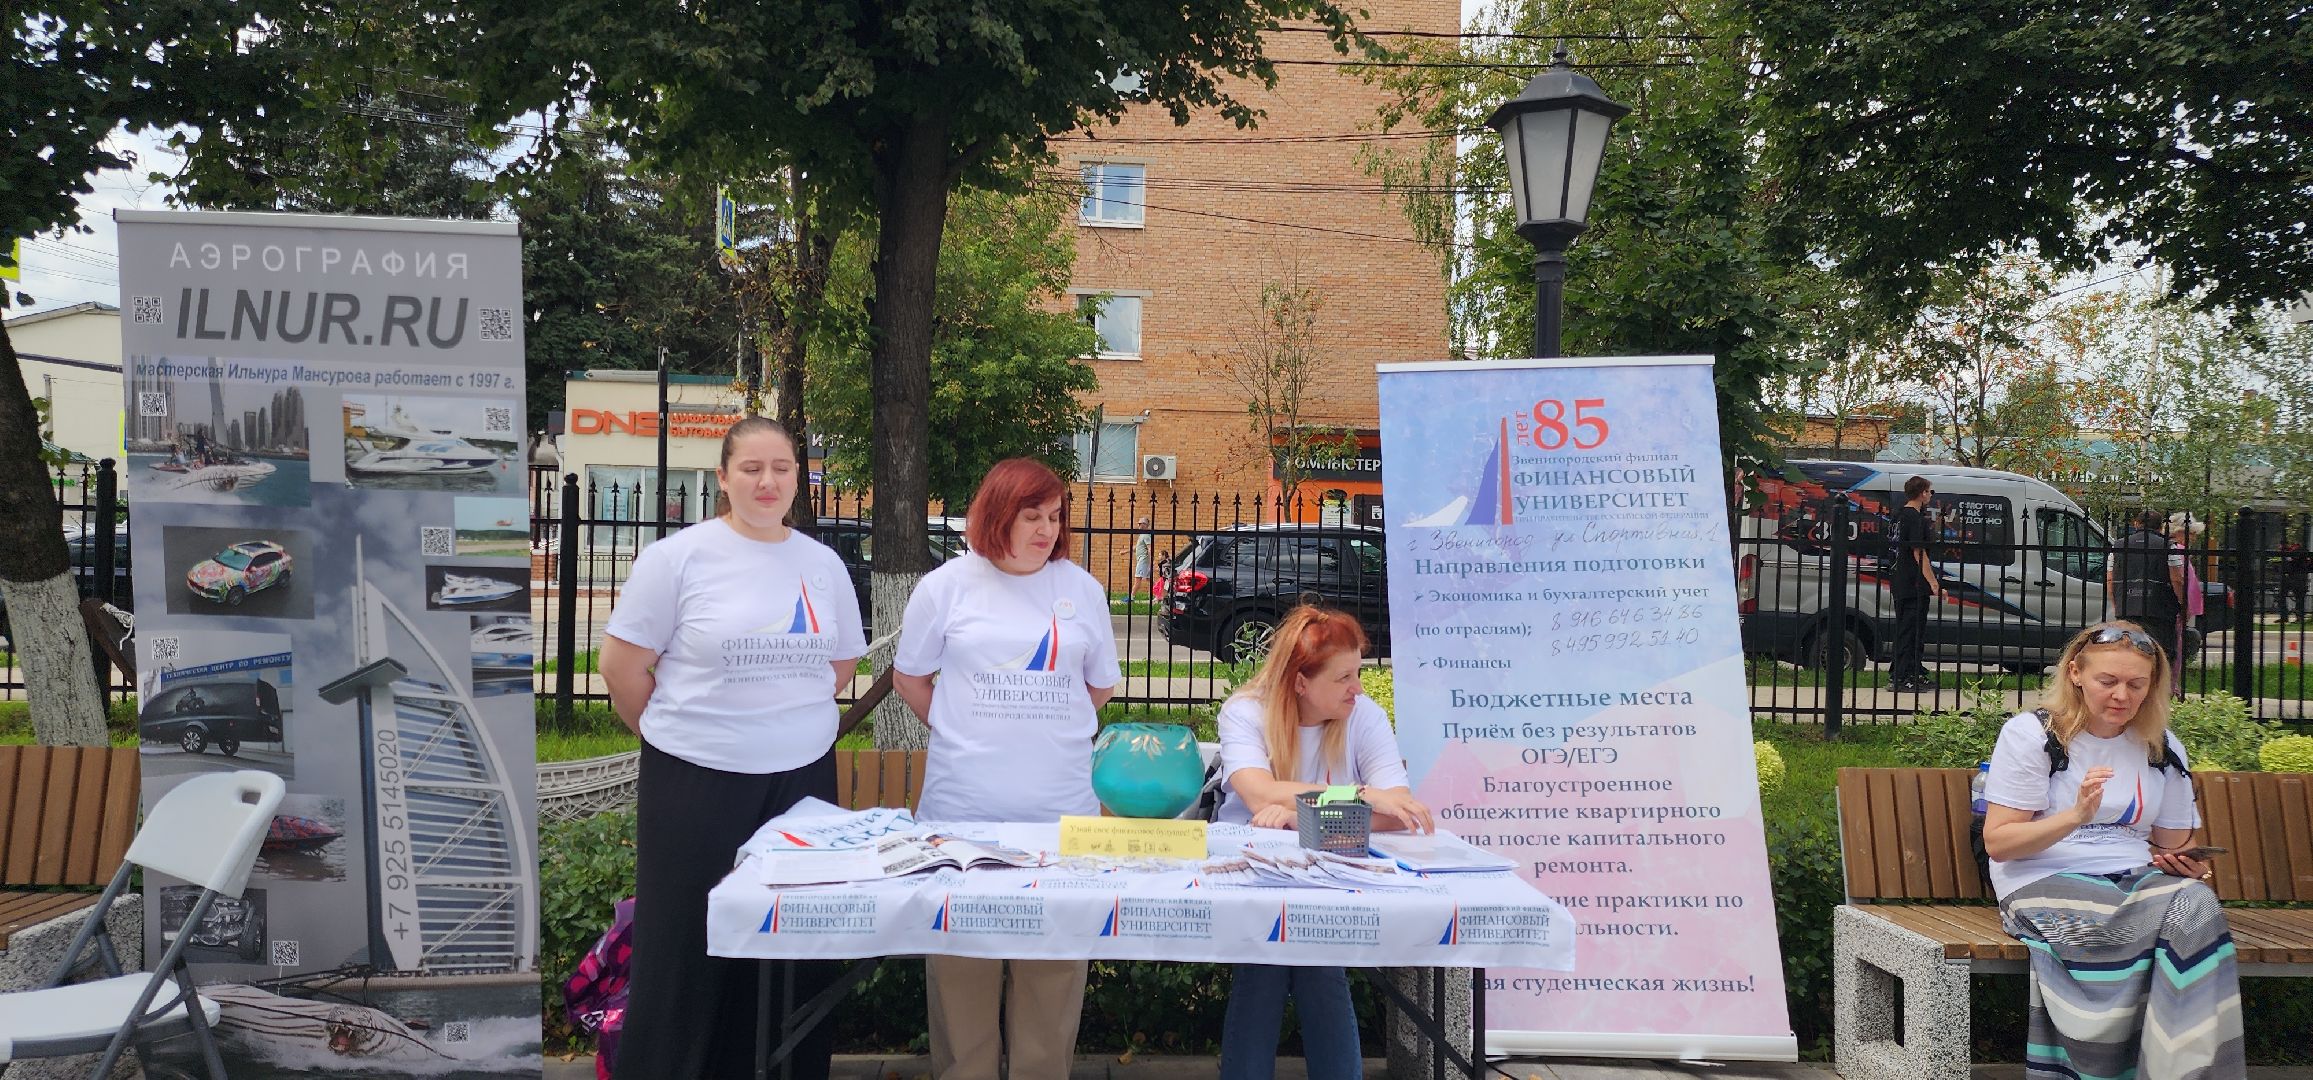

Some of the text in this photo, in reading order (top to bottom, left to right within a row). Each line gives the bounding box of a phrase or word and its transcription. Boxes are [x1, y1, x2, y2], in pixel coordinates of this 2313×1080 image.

[170, 242, 468, 280] АЭРОГРАФИЯ
[177, 288, 469, 349] ILNUR.RU
[136, 361, 515, 389] мастерская Ильнура Мансурова работает с 1997 г.
[572, 409, 659, 437] DNS
[670, 413, 742, 425] ЦИФРОВАЯ
[1533, 399, 1609, 450] 85
[1515, 411, 1530, 447] лет
[1512, 452, 1678, 466] Звенигородский филиал
[1514, 465, 1695, 487] ФИНАНСОВЫЙ
[1514, 493, 1689, 515] УНИВЕРСИТЕТ
[1416, 557, 1705, 579] Направления подготовки
[1429, 587, 1710, 604] Экономика и бухгалтерский учет
[1415, 622, 1532, 639] (по отраслям);
[1433, 656, 1512, 669] Финансы
[973, 672, 1071, 689] ФИНАНСОВЫЙ
[974, 688, 1071, 705] УНИВЕРСИТЕТ
[1450, 689, 1693, 711] Бюджетные места
[1442, 722, 1697, 743] Приём без результатов
[1522, 747, 1618, 768] ОГЭ/ЕГЭ
[1483, 776, 1673, 797] Благоустроенное
[1441, 804, 1721, 824] общежитие квартирного
[377, 729, 412, 940] +7 925 5145020
[1499, 834, 1561, 847] после
[1568, 832, 1726, 847] капитального
[1535, 860, 1633, 878] ремонта.
[780, 900, 877, 914] ФИНАНСОВЫЙ
[950, 903, 1044, 916] ФИНАНСОВЫЙ
[1120, 905, 1212, 920] ФИНАНСОВЫЙ
[1596, 895, 1708, 914] практики
[1715, 895, 1744, 909] по
[781, 916, 877, 928] УНИВЕРСИТЕТ
[951, 916, 1044, 930] УНИВЕРСИТЕТ
[1120, 920, 1213, 933] УНИВЕРСИТЕТ
[1287, 913, 1381, 927] ФИНАНСОВЫЙ
[1460, 914, 1550, 927] ФИНАНСОВЫЙ
[1288, 926, 1381, 940] УНИВЕРСИТЕТ
[1459, 929, 1550, 940] УНИВЕРСИТЕТ
[1576, 922, 1679, 936] льности.
[1512, 977, 1665, 997] студенческая
[1671, 974, 1756, 992] жизнь!
